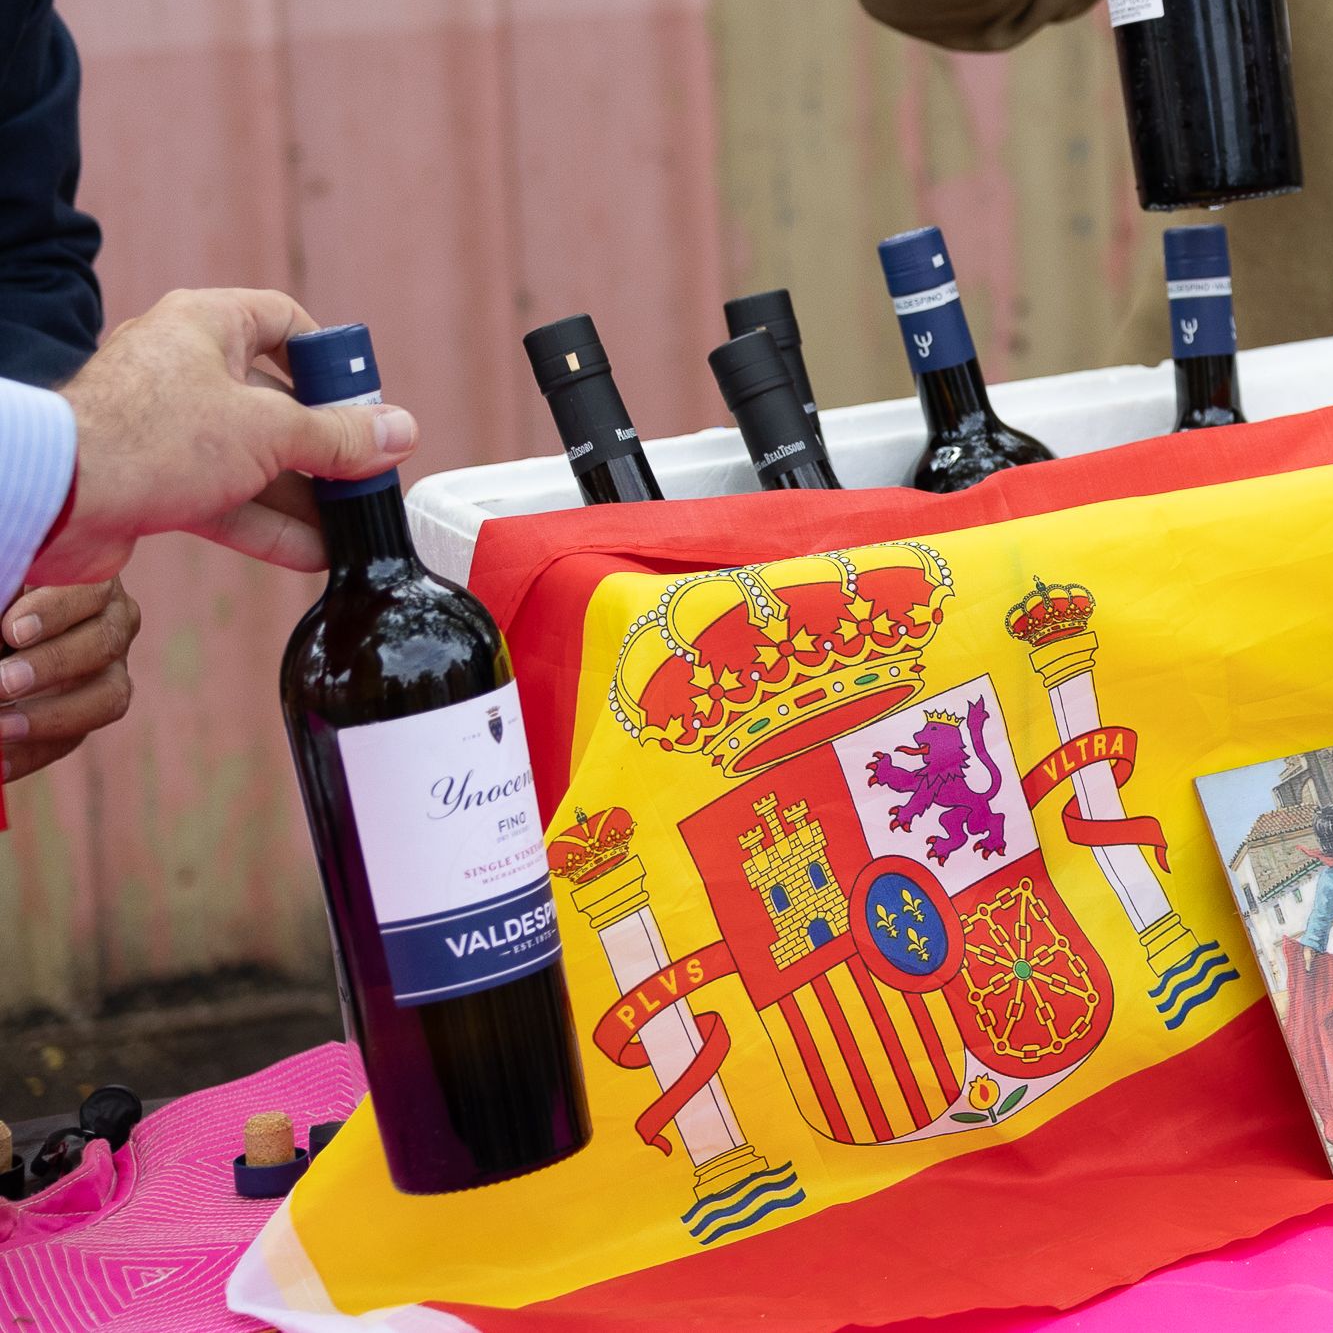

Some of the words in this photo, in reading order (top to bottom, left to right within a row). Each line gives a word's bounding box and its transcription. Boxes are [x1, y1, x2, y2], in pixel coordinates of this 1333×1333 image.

[1042, 733, 1125, 782] VLTRA
[427, 764, 535, 820] Ynocen
[497, 811, 528, 833] FINO
[464, 856, 512, 880] SINGLE
[617, 957, 706, 1030] PLVS
